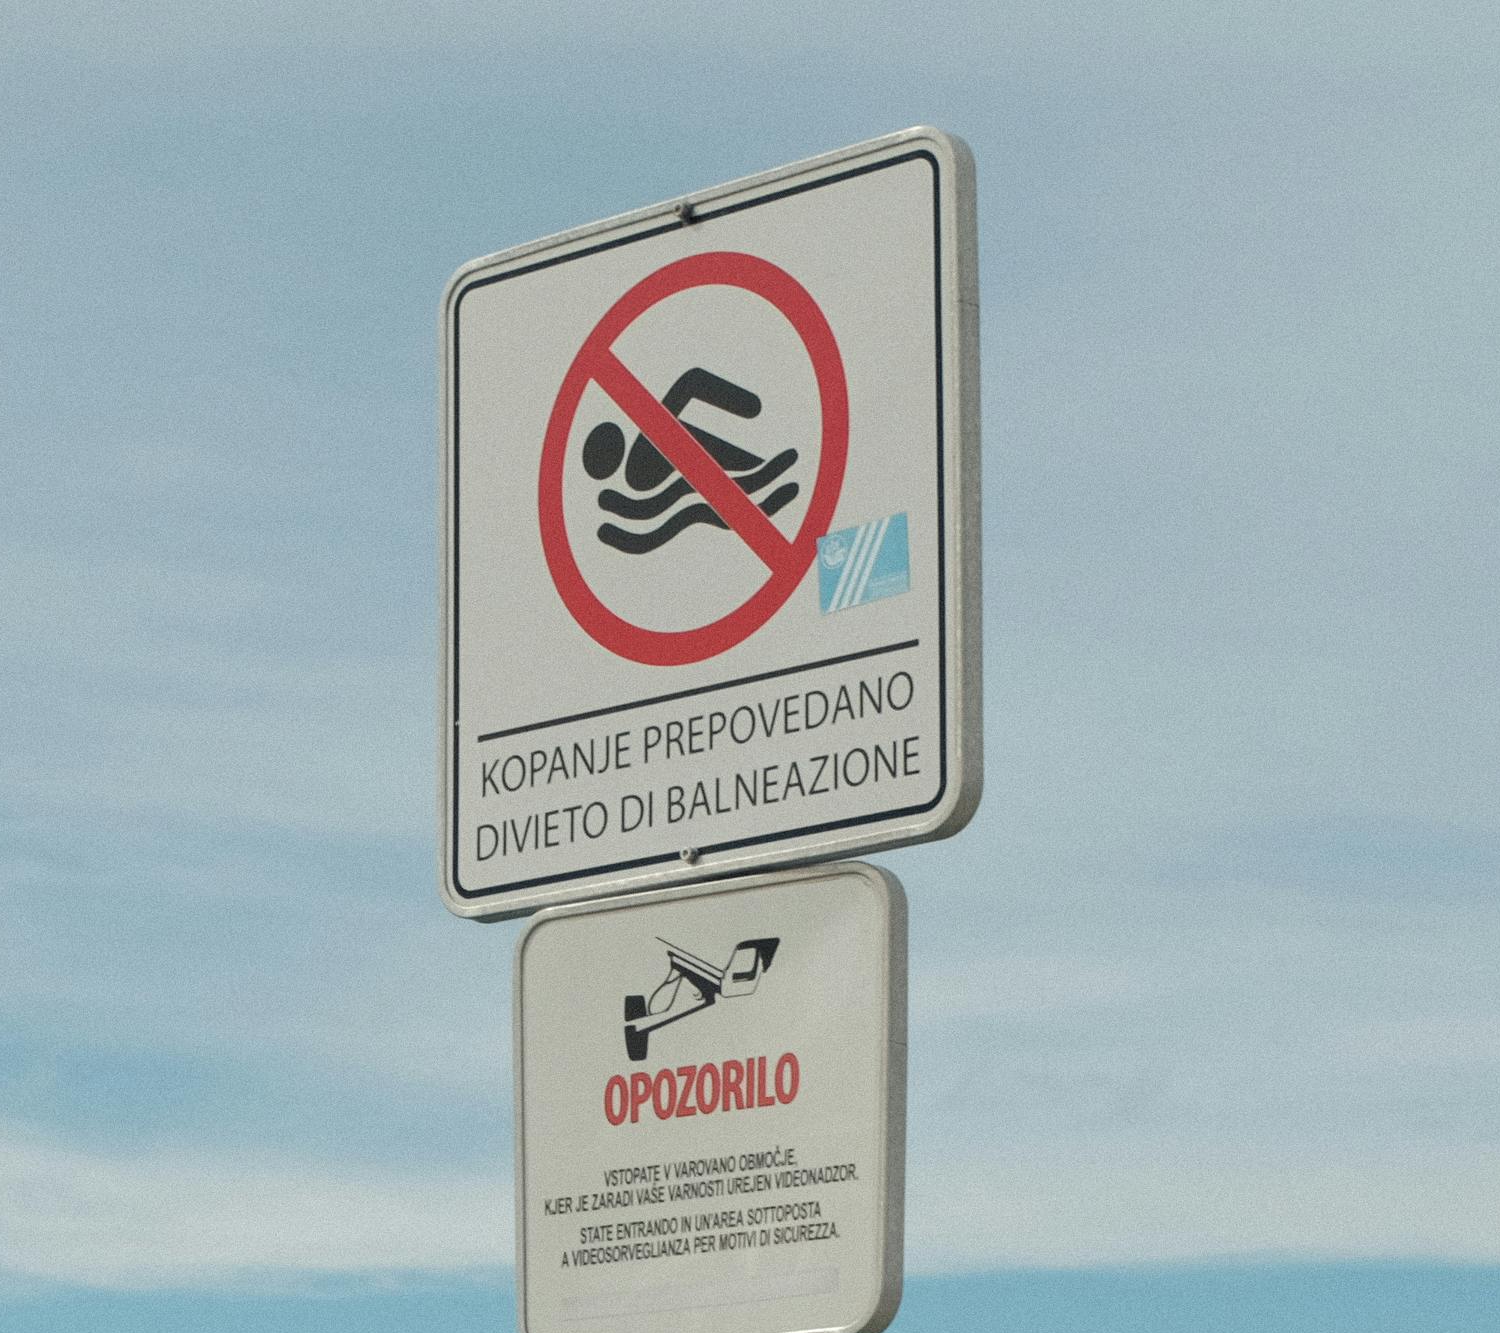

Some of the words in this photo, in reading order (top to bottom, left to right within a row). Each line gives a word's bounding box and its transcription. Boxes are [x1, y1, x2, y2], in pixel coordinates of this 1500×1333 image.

[481, 731, 631, 797] KOPANJE
[643, 671, 915, 764] PREPOVEDANO
[476, 802, 608, 862] DIVIETO
[620, 791, 654, 834] DI
[667, 736, 921, 824] BALNEAZIONE
[603, 1051, 800, 1126] OPOZORILO
[544, 1196, 573, 1215] KJER
[575, 1194, 589, 1213] JE
[591, 1190, 634, 1211] ZARADI
[636, 1184, 666, 1205] VAŠE
[667, 1178, 724, 1201] VARNOSTI
[727, 1174, 772, 1195] UREJEN
[774, 1163, 859, 1189] VIDEONADZOR.
[604, 1164, 660, 1187] VSTOPATE
[664, 1163, 672, 1180] V
[673, 1155, 735, 1178] VAROVANO
[561, 1251, 570, 1268] A
[571, 1238, 691, 1268] VIDEOSORVEGLIANZA
[693, 1235, 716, 1254] PER
[719, 1230, 757, 1251] MOTIVI
[759, 1228, 771, 1247] DI
[773, 1222, 841, 1245] SICUREZZA.
[580, 1223, 613, 1244] STATE
[616, 1216, 678, 1241] ENTRANDO
[680, 1215, 692, 1233] IN
[747, 1201, 822, 1226] SOTTOPOSTA
